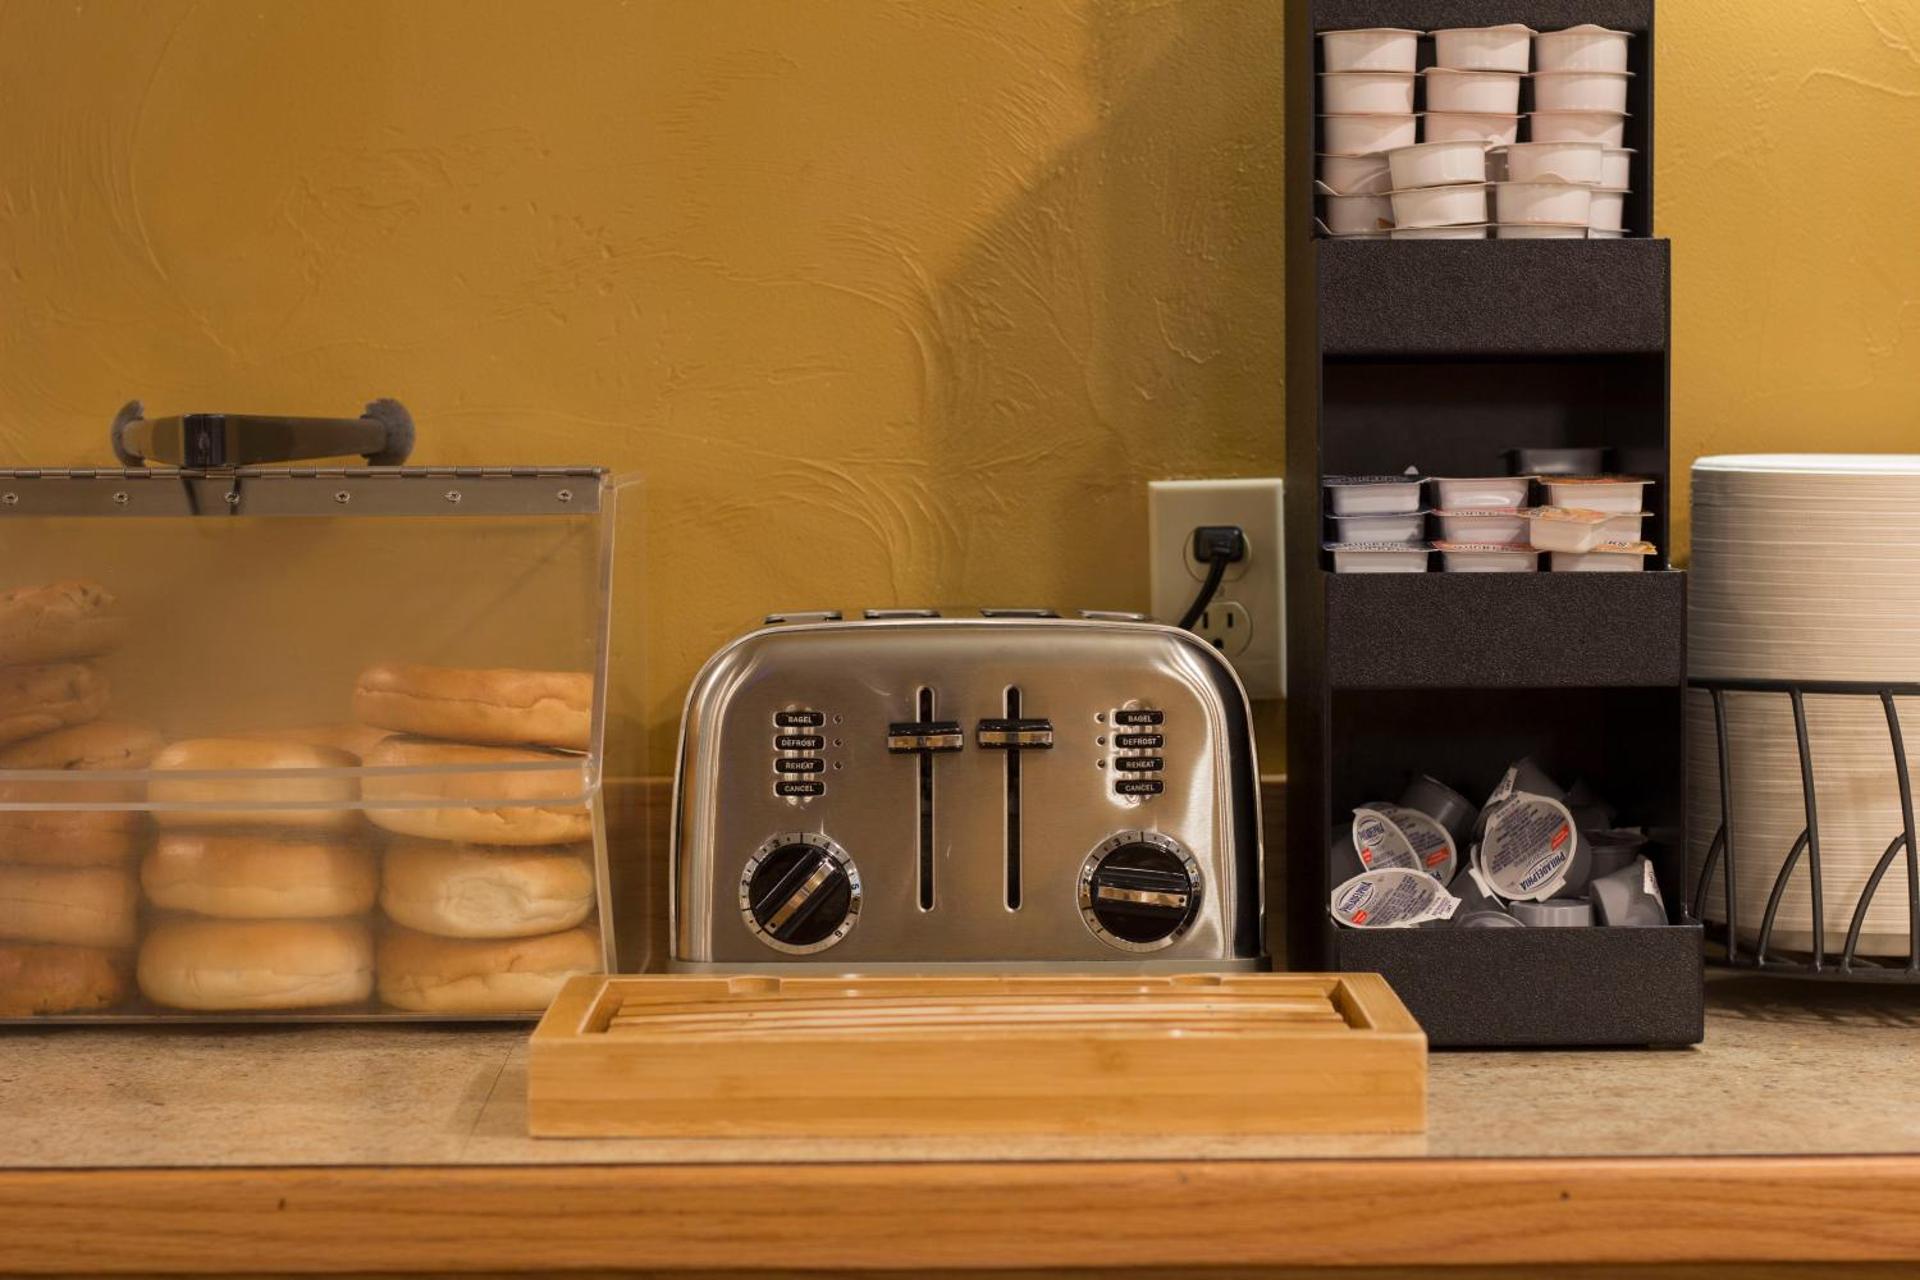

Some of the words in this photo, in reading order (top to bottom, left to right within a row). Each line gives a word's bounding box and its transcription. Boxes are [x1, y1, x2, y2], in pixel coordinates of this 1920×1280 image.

[1128, 715, 1152, 723] BAGEL
[781, 739, 815, 747] DEFROST
[1122, 738, 1157, 746] DEFROST
[1125, 784, 1154, 792] CANCEL
[1519, 851, 1567, 891] PHILADELPHIA
